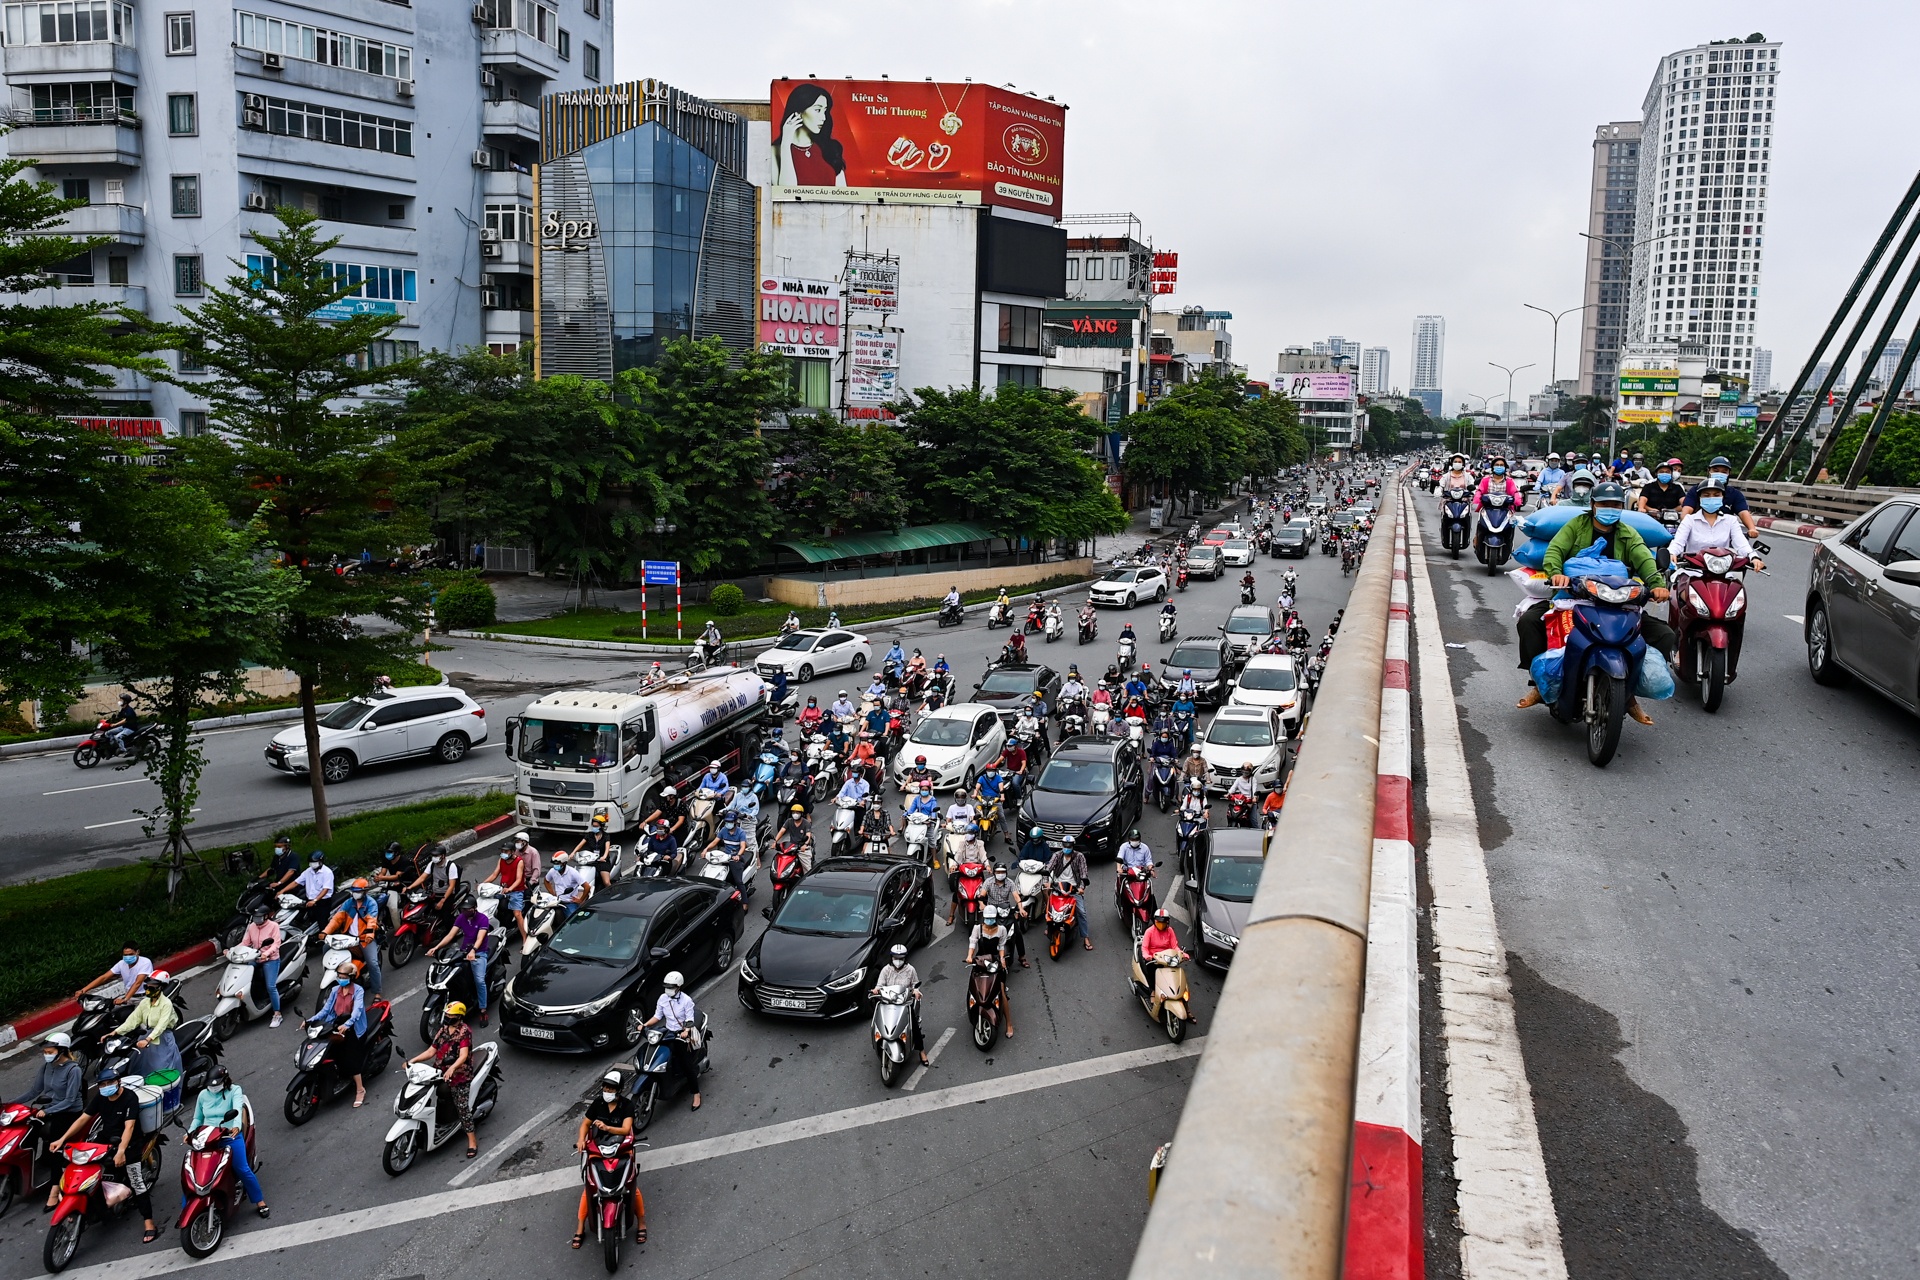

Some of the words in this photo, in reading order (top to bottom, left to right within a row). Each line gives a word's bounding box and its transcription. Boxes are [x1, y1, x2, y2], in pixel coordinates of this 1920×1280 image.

[559, 93, 593, 106] THANH
[876, 93, 889, 103] Sa
[676, 100, 709, 116] BEAUTY
[708, 108, 738, 124] CENTER
[890, 106, 928, 119] Thượng
[988, 101, 1001, 110] TẬP
[1002, 105, 1020, 115] ĐOÀN
[1021, 109, 1038, 120] VÀNG
[1052, 118, 1062, 127] TÍN
[987, 161, 1005, 173] BẢO
[1006, 165, 1020, 176] TÍN
[1021, 169, 1045, 182] MẠNH
[1046, 174, 1060, 186] HẢI
[998, 186, 1007, 195] 39
[1008, 188, 1035, 199] NGUYỄN
[542, 210, 594, 248] Spa
[782, 280, 804, 293] NHÀ
[807, 284, 829, 295] MAY
[762, 296, 837, 326] HOÀNG
[1072, 315, 1118, 333] VÀNG
[774, 325, 825, 345] QUỐC
[855, 339, 868, 347] BÚN
[803, 347, 830, 355] VESTON
[855, 348, 868, 356] BÚN
[1654, 383, 1664, 391] PHỤ
[109, 418, 164, 437] CINEMA
[700, 708, 718, 727] VƯỜN
[728, 697, 738, 712] HÀ
[736, 692, 748, 708] NỘI
